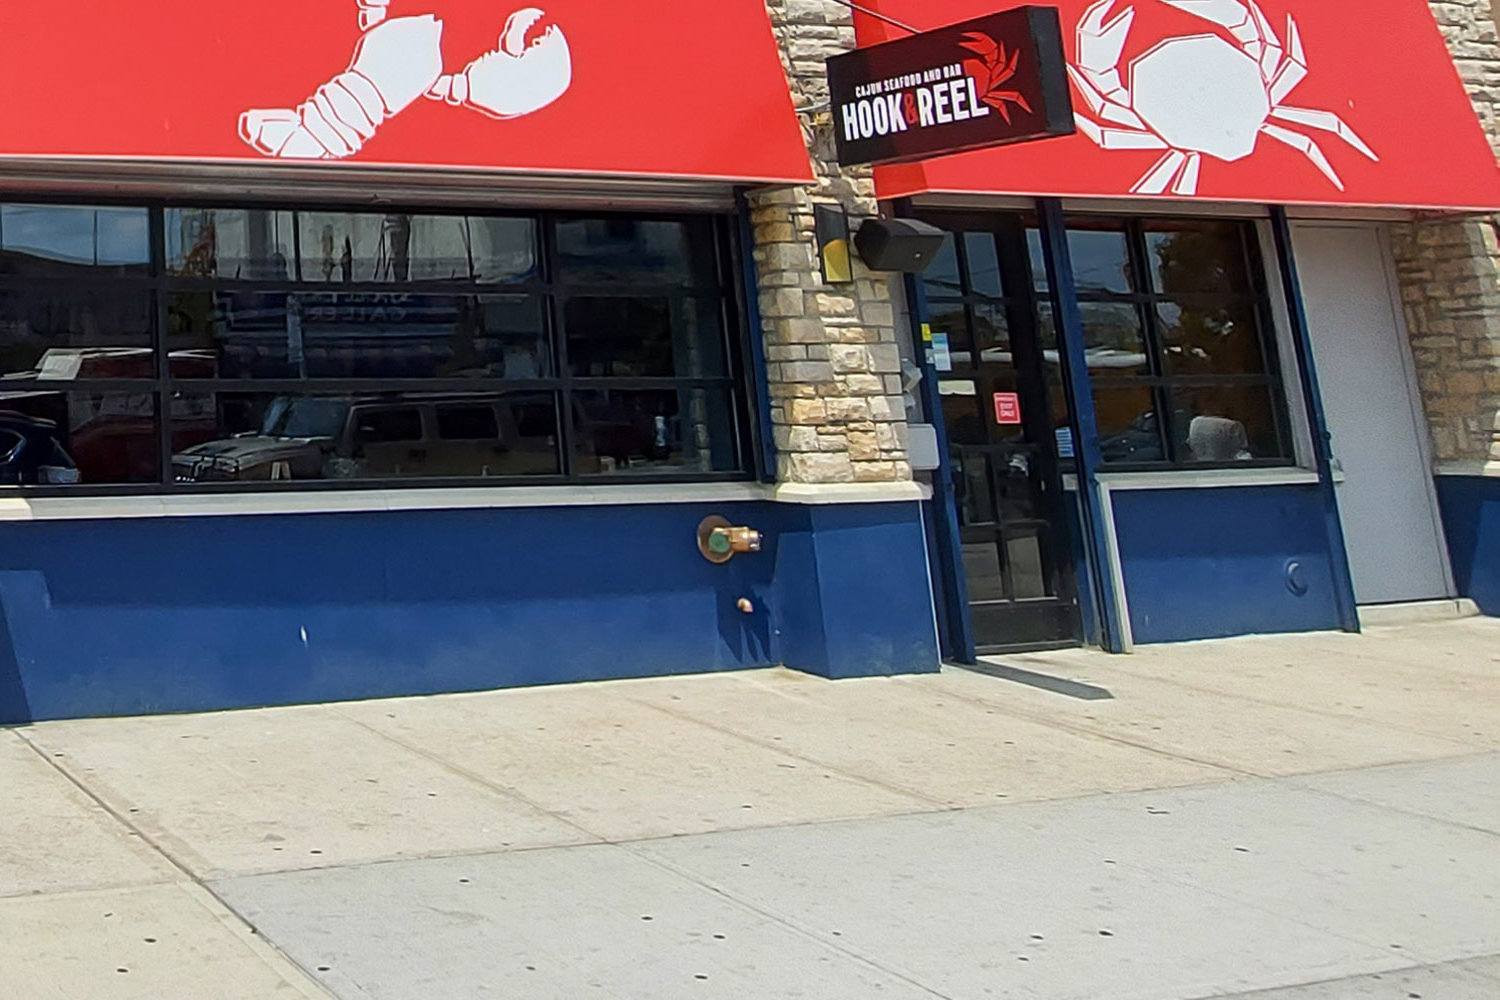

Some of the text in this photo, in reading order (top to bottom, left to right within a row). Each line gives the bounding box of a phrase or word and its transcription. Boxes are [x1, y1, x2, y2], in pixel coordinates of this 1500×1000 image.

[855, 62, 963, 98] CAJUN SEAFOOD AND BAR
